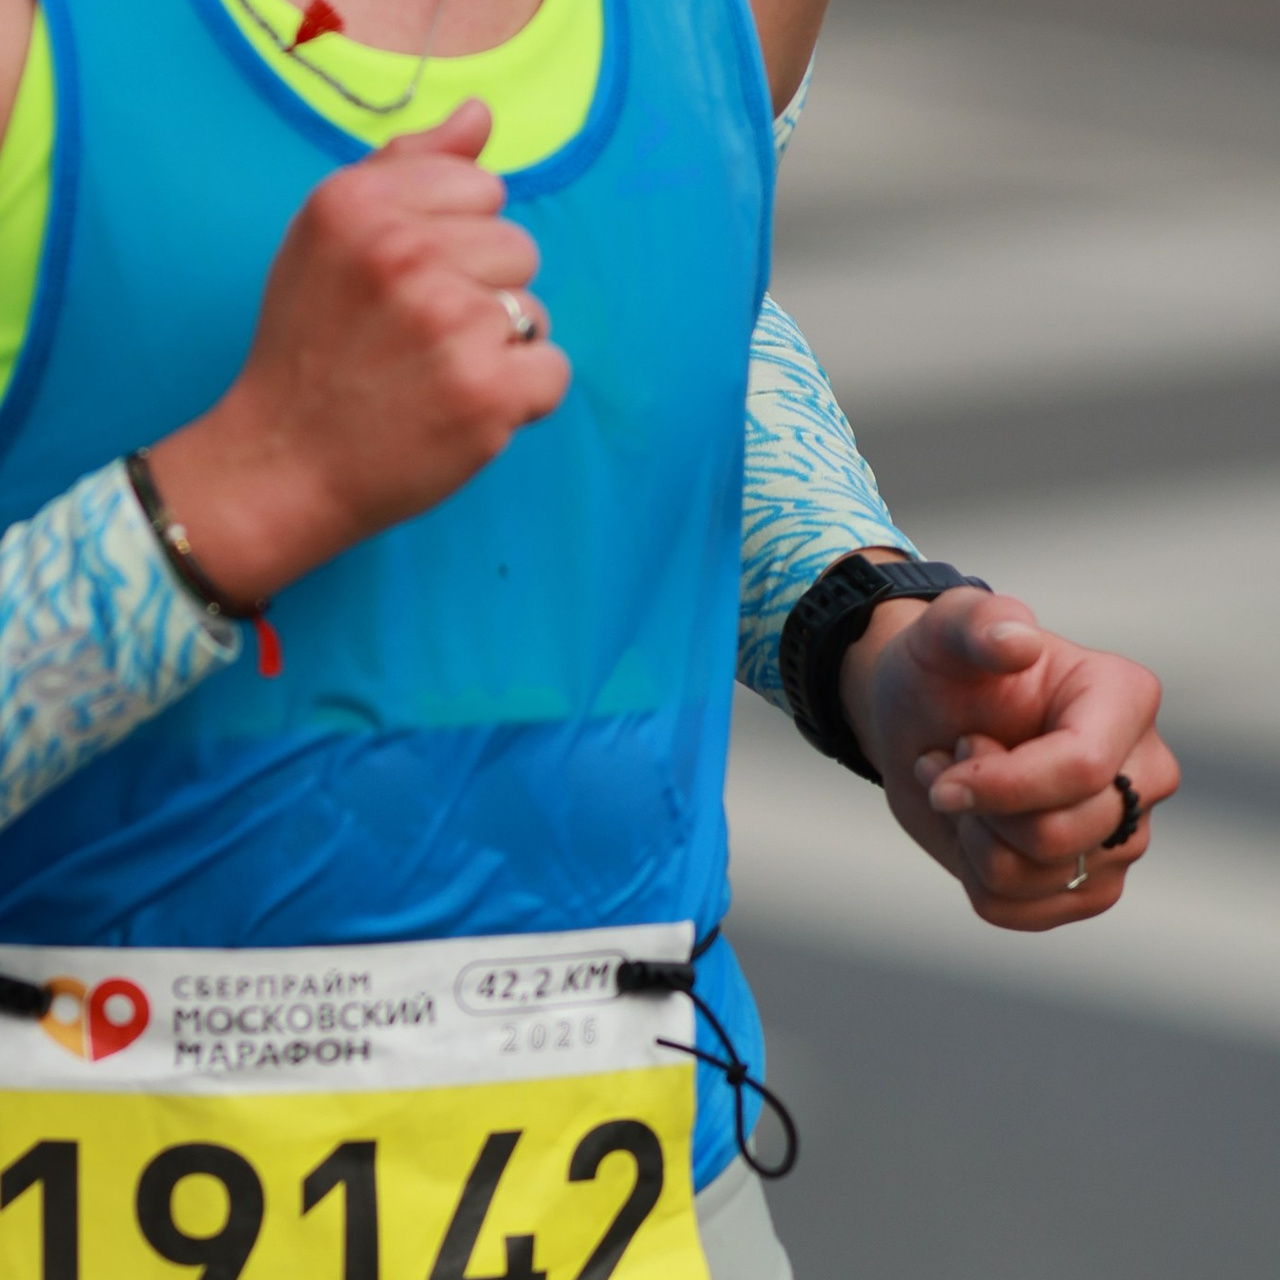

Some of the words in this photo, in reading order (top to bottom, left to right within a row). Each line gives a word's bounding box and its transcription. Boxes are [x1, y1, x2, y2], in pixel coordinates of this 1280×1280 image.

[172, 968, 371, 1001] СБЕРПРАЙМ
[476, 969, 552, 1002] 42,2
[173, 990, 437, 1035] МОСКОВСКИЙ
[500, 1016, 599, 1057] 2026
[173, 1037, 372, 1070] МАРАФОН
